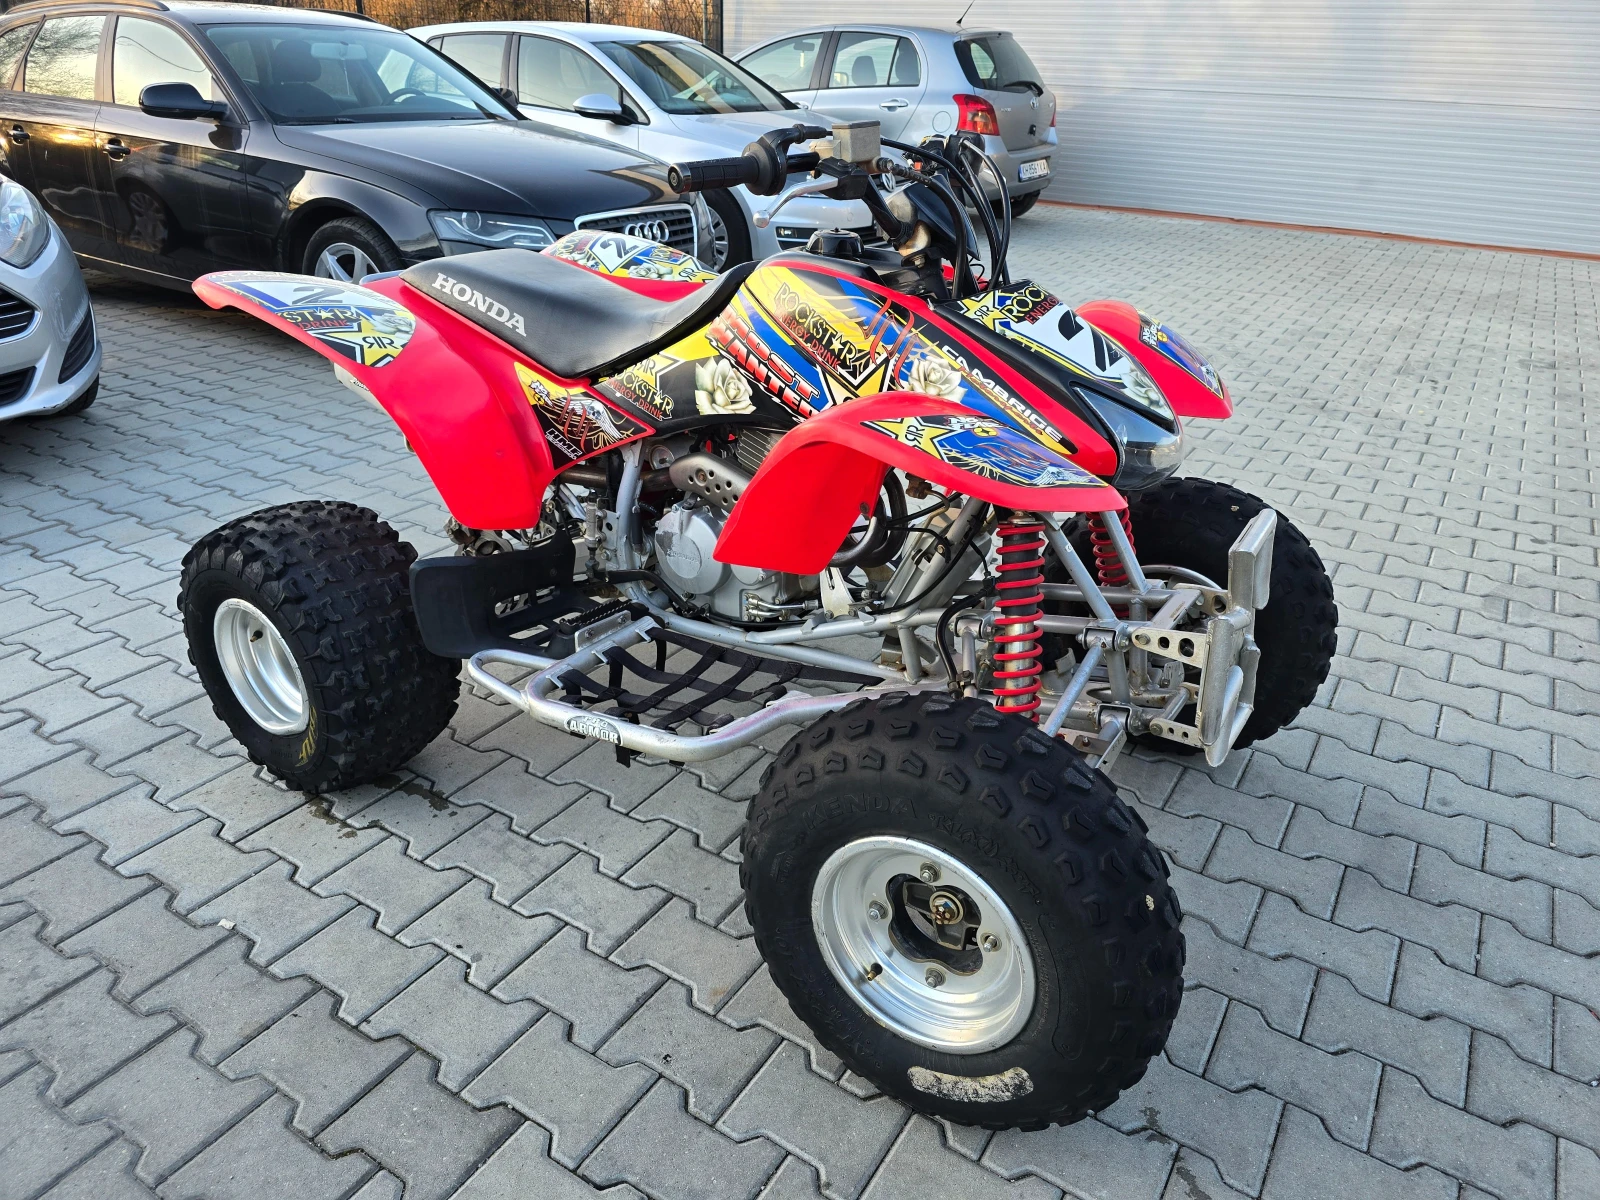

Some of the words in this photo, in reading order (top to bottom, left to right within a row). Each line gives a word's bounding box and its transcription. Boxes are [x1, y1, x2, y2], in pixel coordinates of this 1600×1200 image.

[292, 286, 345, 304] 2
[431, 272, 527, 337] HONDA
[299, 319, 349, 330] DRINK
[774, 282, 857, 366] ROCKSTAR
[1058, 309, 1124, 372] 2
[719, 304, 820, 402] MOST
[811, 339, 842, 370] DRINK
[638, 399, 663, 419] DRINK
[942, 345, 1063, 442] CAMBRIGE
[570, 720, 618, 744] ARMOR
[801, 791, 919, 831] KENDA
